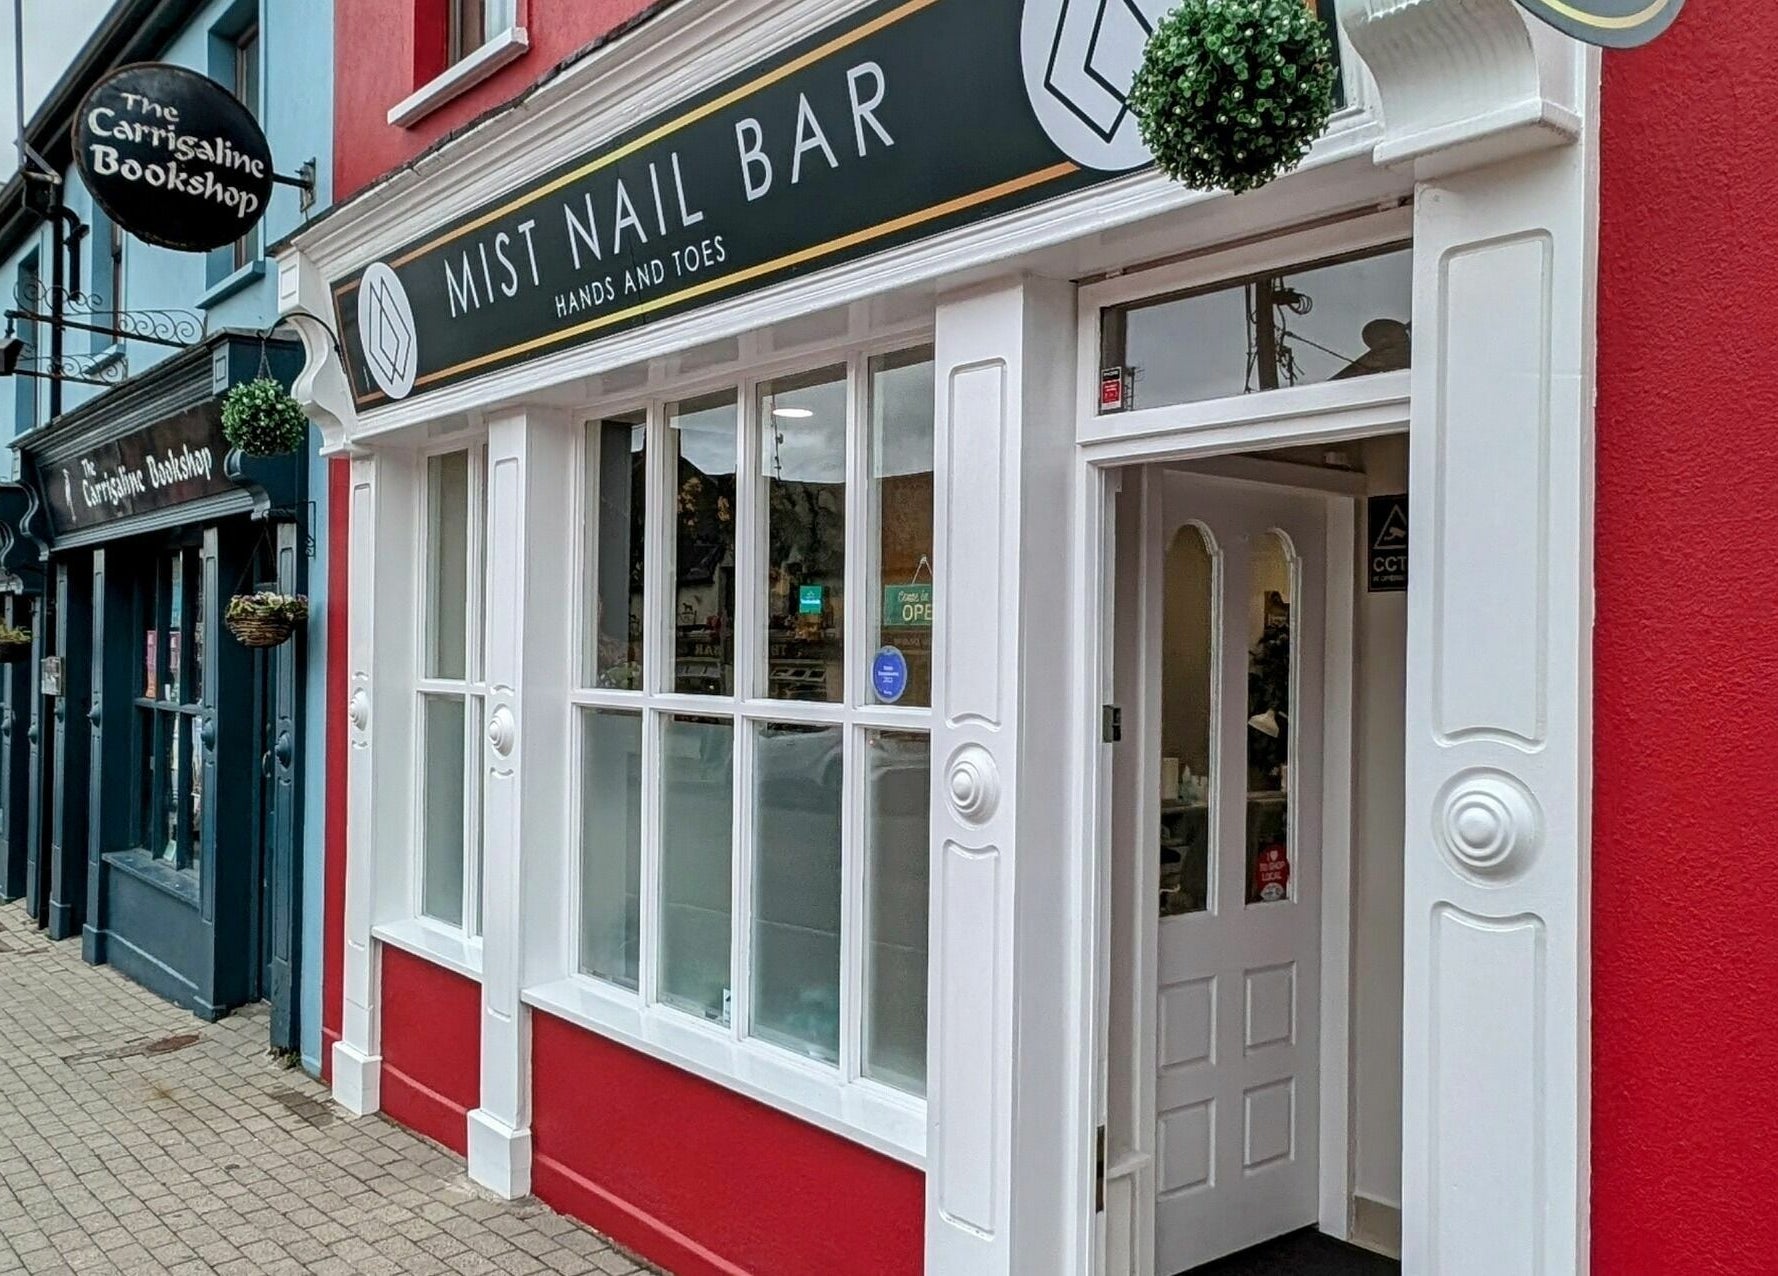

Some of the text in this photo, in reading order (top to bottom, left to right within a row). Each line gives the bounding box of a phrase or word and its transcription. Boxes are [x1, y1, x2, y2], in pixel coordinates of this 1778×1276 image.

[120, 93, 179, 122] The
[88, 107, 264, 178] Carrigaline
[89, 144, 258, 218] Bookshop
[444, 60, 895, 318] MIST NAIL BAR
[554, 236, 726, 318] HANDS AND TOES
[81, 458, 96, 478] The
[82, 443, 213, 508] Carrigaline Bookshop
[1373, 555, 1407, 572] CCT
[902, 604, 932, 621] OPE
